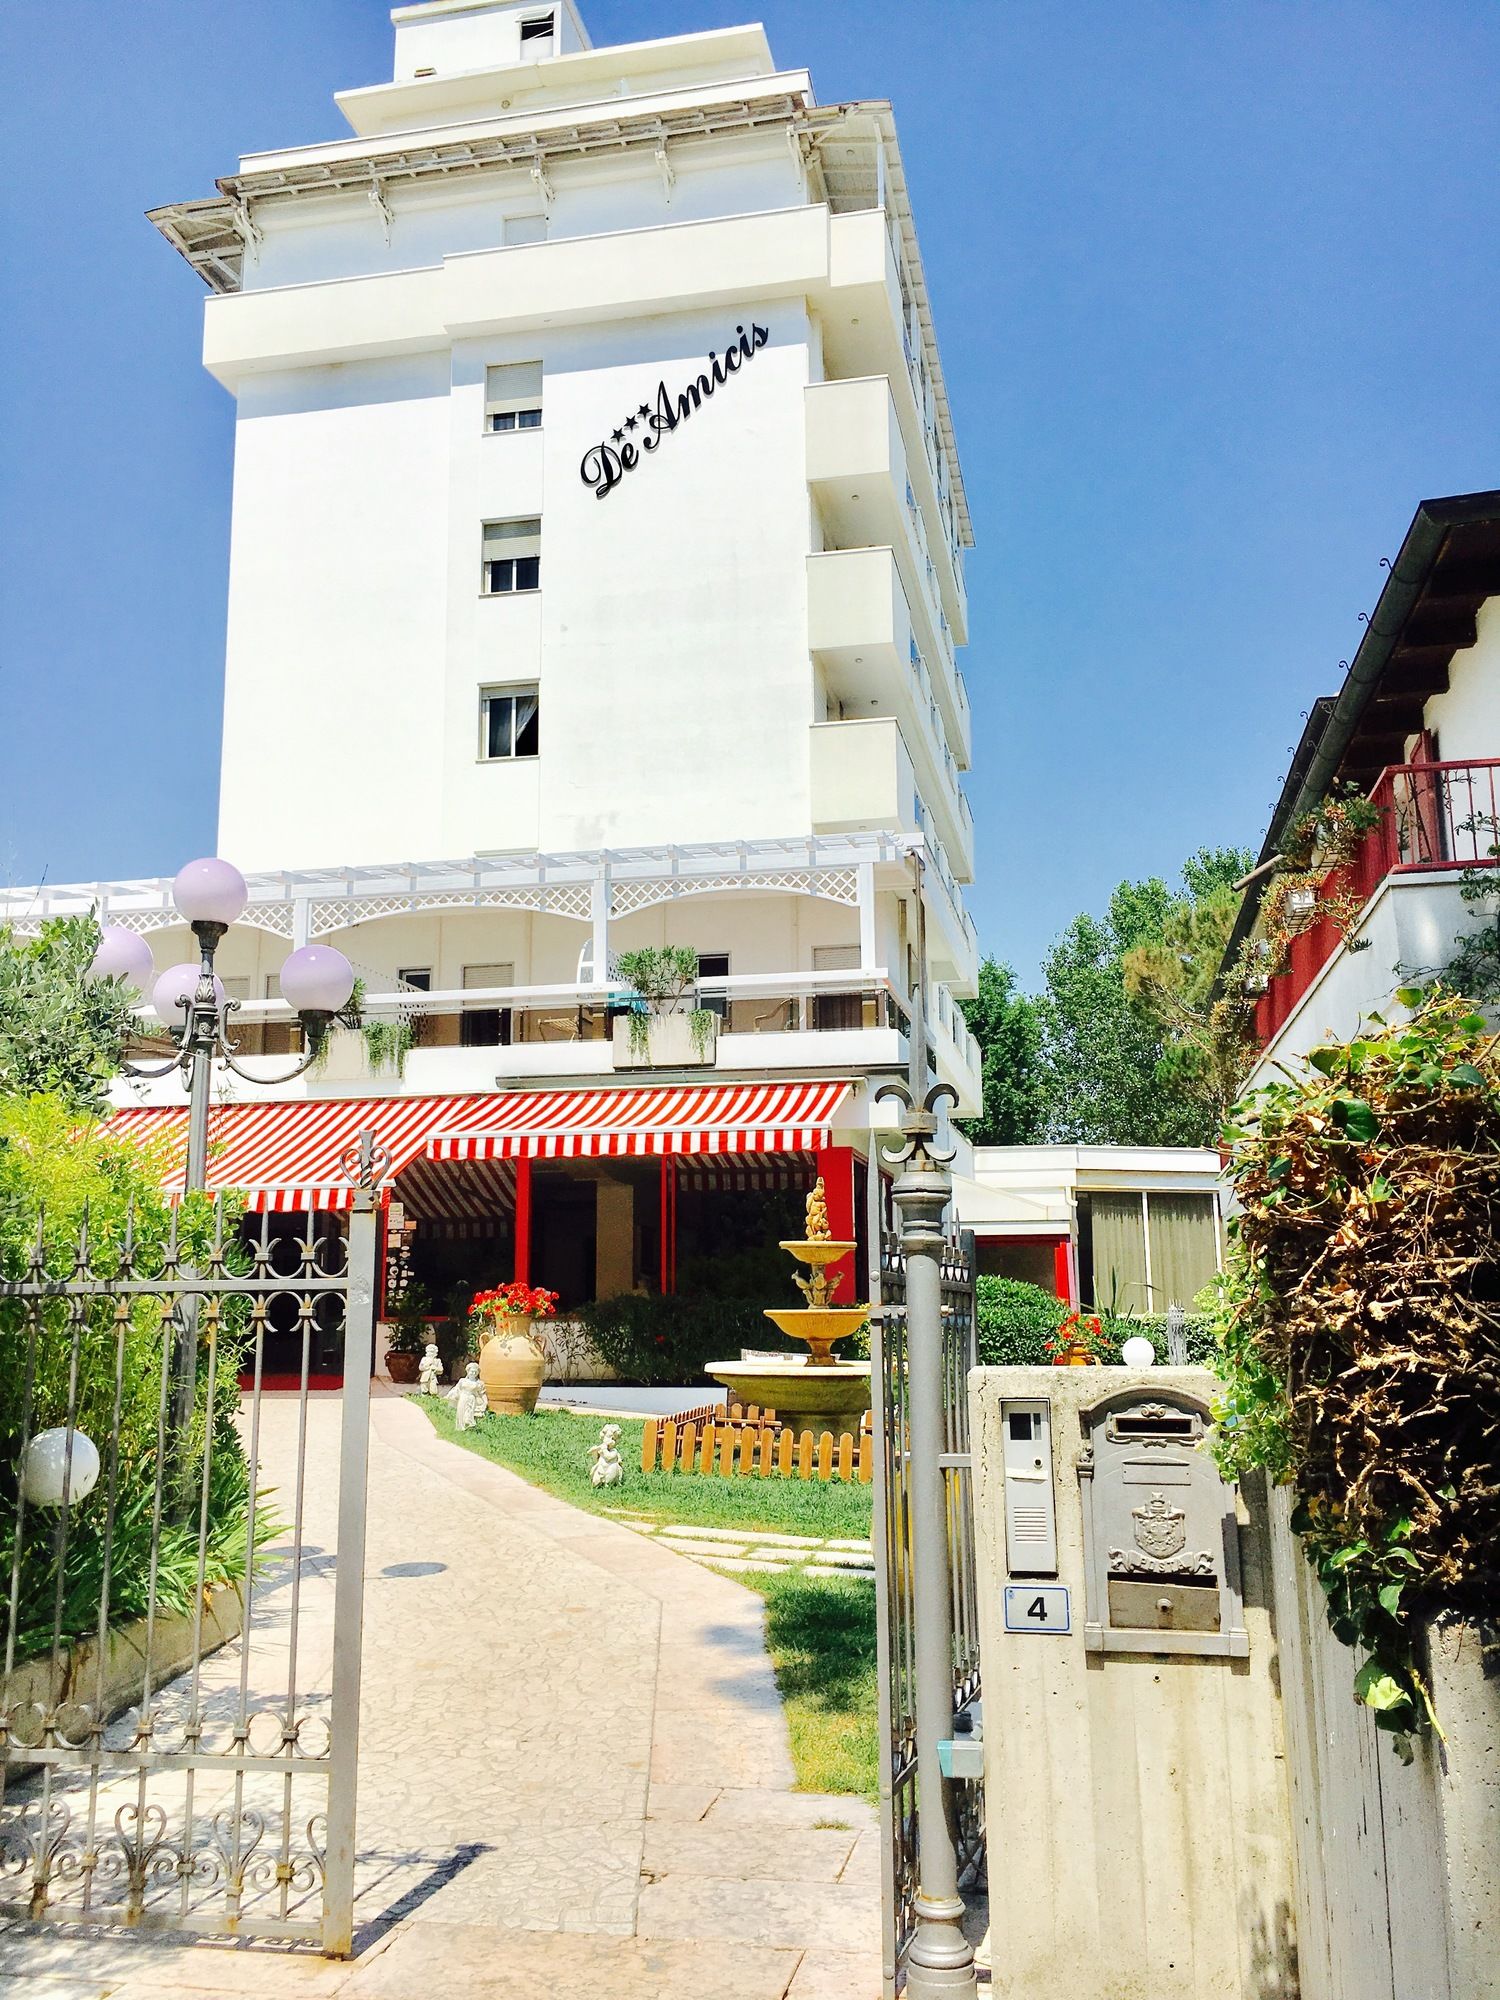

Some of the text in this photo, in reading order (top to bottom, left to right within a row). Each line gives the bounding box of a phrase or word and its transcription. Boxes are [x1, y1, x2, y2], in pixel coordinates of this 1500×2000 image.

[580, 323, 769, 498] De Amicis
[1139, 1557, 1187, 1573] POSTA
[1027, 1596, 1048, 1621] 4
